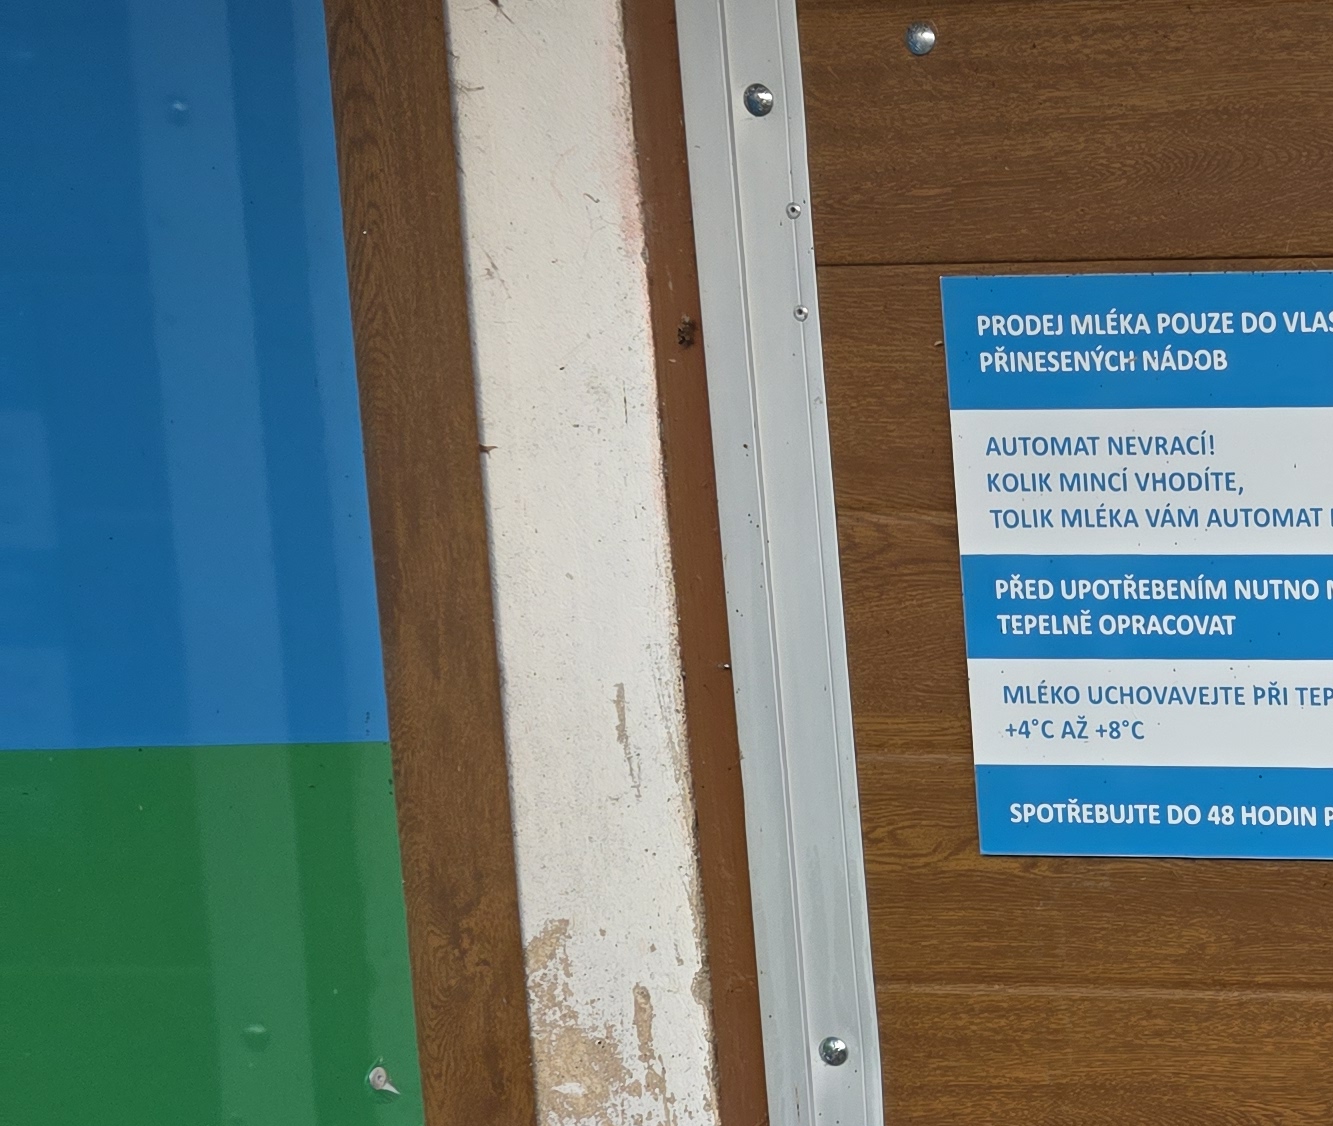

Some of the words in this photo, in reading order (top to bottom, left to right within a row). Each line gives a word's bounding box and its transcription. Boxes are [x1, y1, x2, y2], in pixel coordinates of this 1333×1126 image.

[978, 315, 1063, 336] PRODEJ
[1071, 308, 1150, 334] MLÉKA
[1157, 313, 1234, 334] POUZE
[1242, 312, 1276, 333] DO
[980, 345, 1135, 372] PŘINESENÝCH
[1143, 345, 1227, 371] NÁDOB
[986, 437, 1100, 456] AUTOMAT
[1108, 430, 1214, 455] NEVRACÍ!
[988, 473, 1052, 492] KOLIK
[1060, 467, 1127, 492] MINCÍ
[1135, 467, 1243, 495] VHODÍTE,
[990, 509, 1053, 528] TOLIK
[1061, 503, 1138, 527] MLÉKA
[1145, 503, 1198, 527] VÁM
[1207, 508, 1323, 527] AUTOMAT
[996, 574, 1053, 599] PŘED
[1061, 574, 1227, 599] UPOTŘEBENÍM
[1235, 580, 1319, 600] NUTNO
[997, 610, 1092, 634] TEPELNĚ
[1099, 615, 1236, 635] OPRACOVAT
[1004, 680, 1080, 704] MLÉKO
[1088, 686, 1245, 705] UCHOVAVEJTE
[1253, 682, 1287, 705] PŘI
[1006, 719, 1054, 738] +4°C
[1061, 716, 1088, 739] AŽ
[1096, 720, 1144, 739] +8°C
[1010, 799, 1160, 824] SPOTŘEBUJTE
[1168, 805, 1201, 824] DO
[1208, 806, 1234, 825] 48
[1242, 806, 1316, 826] HODIN
